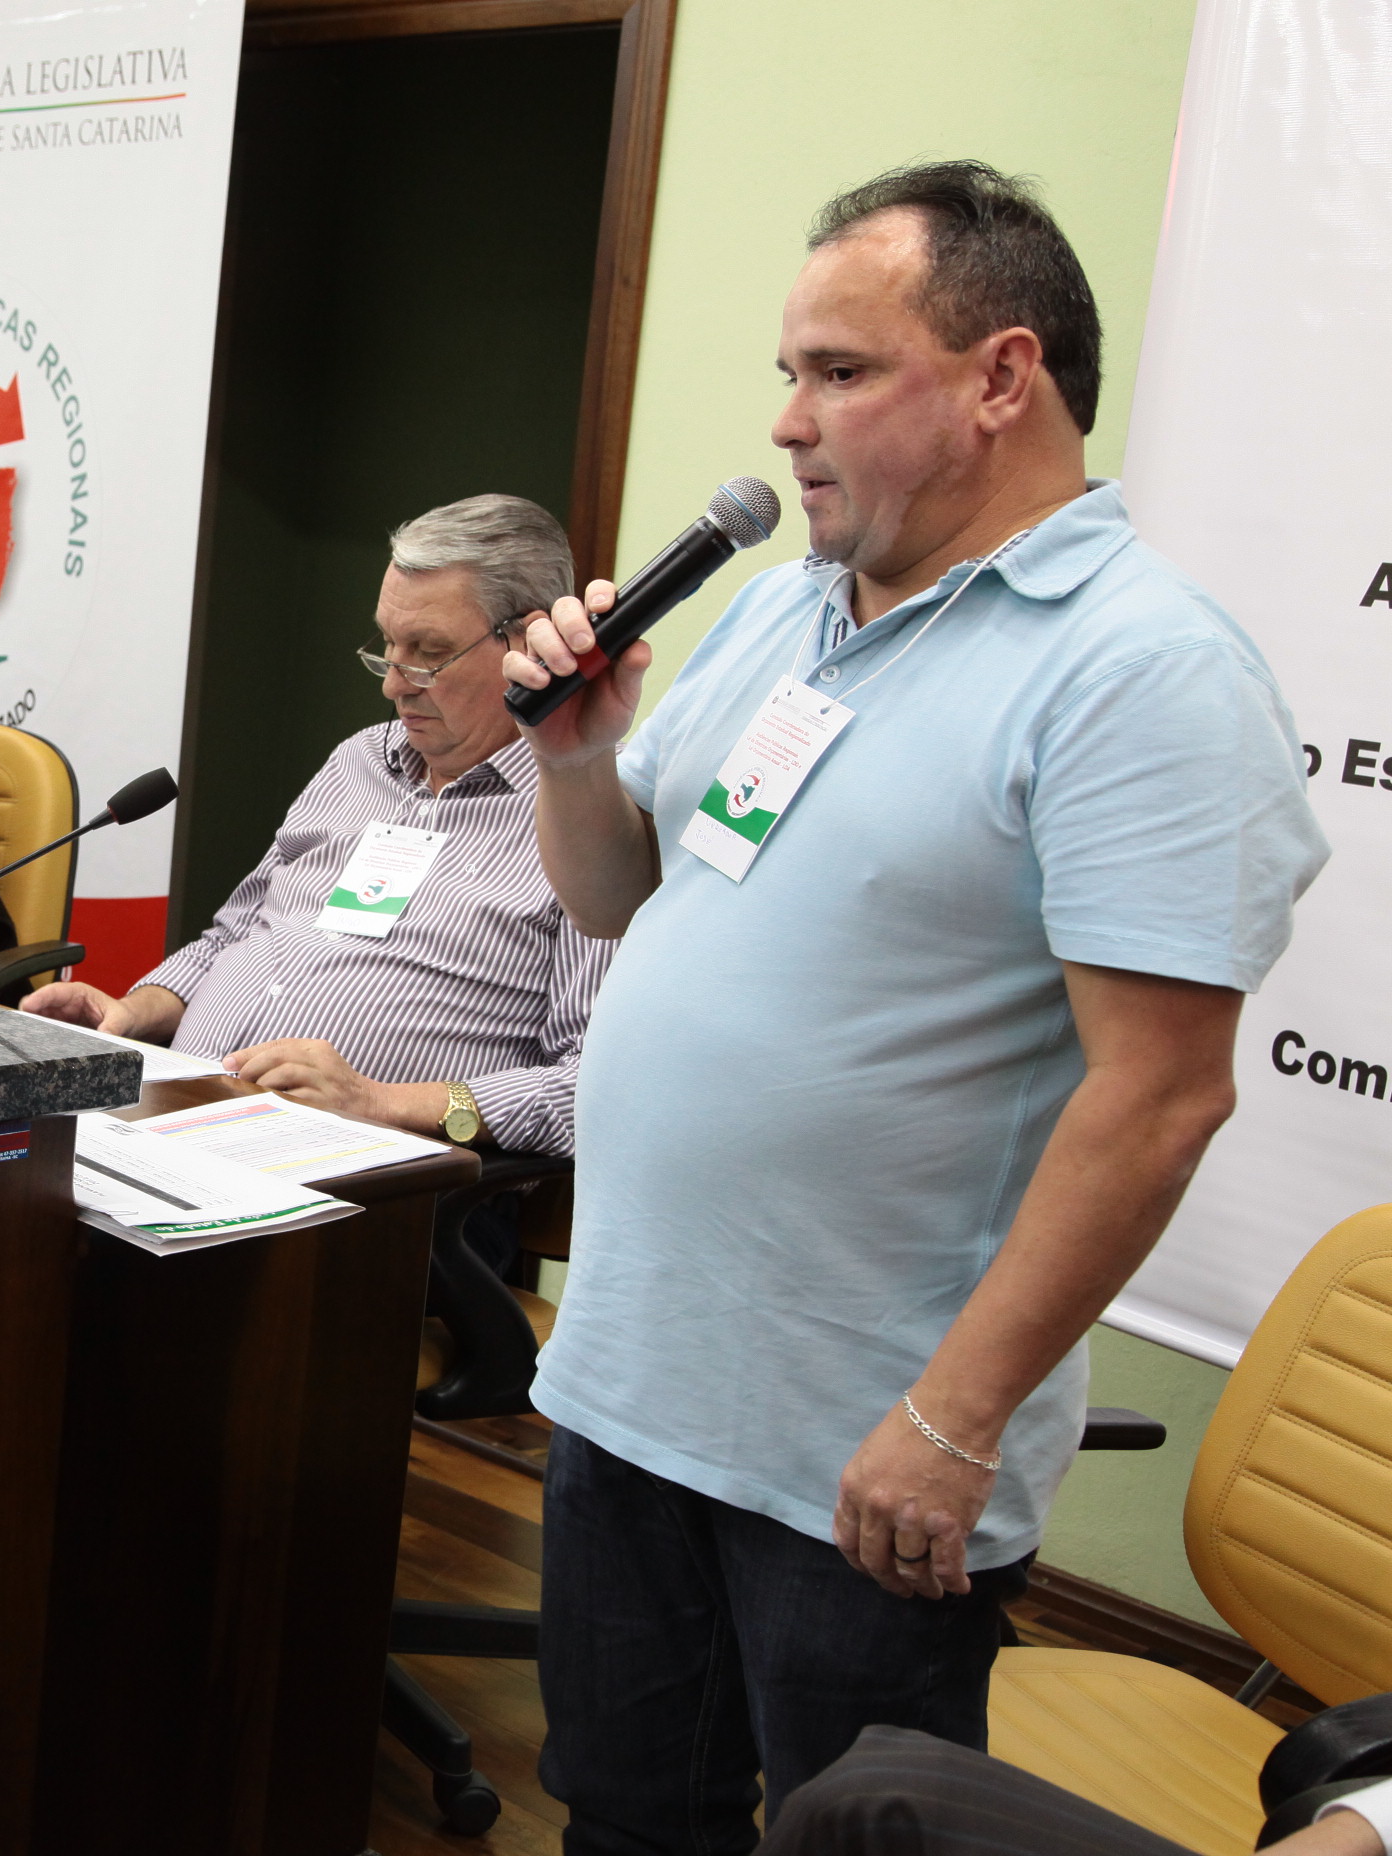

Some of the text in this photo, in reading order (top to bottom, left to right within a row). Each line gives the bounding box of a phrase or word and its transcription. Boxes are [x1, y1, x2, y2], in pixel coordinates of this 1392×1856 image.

[25, 46, 188, 95] LEGISLATIVA
[10, 121, 72, 151] SANTA
[78, 112, 184, 146] CATARINA
[37, 342, 89, 578] REGIONAIS
[1272, 1029, 1392, 1102] Com
